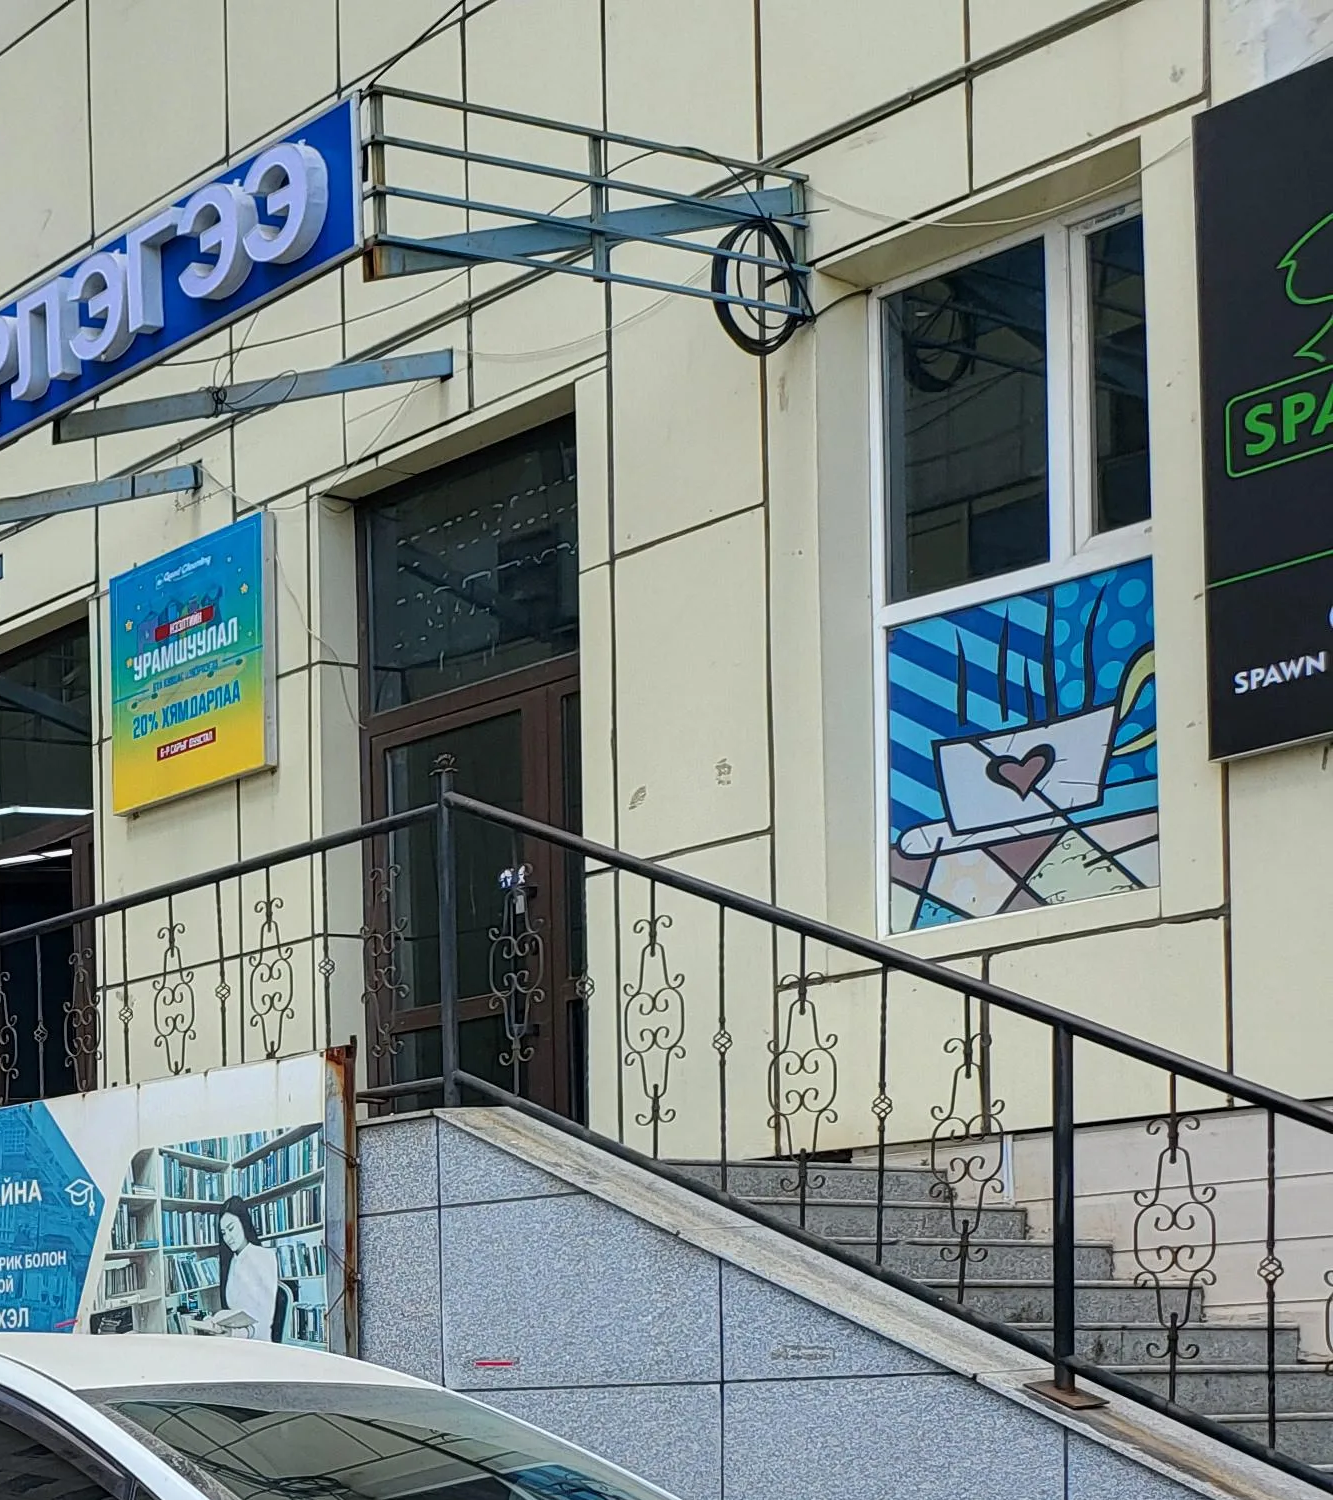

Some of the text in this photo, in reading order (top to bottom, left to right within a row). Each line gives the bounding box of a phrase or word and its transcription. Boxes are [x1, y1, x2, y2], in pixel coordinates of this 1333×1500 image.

[133, 616, 238, 682] УРАМШУУЛАЛ
[1234, 650, 1328, 695] SPAWN
[132, 710, 159, 740] 20%
[161, 679, 242, 729] ХЯМДАРЛАА
[25, 1250, 67, 1269] БОЛОН
